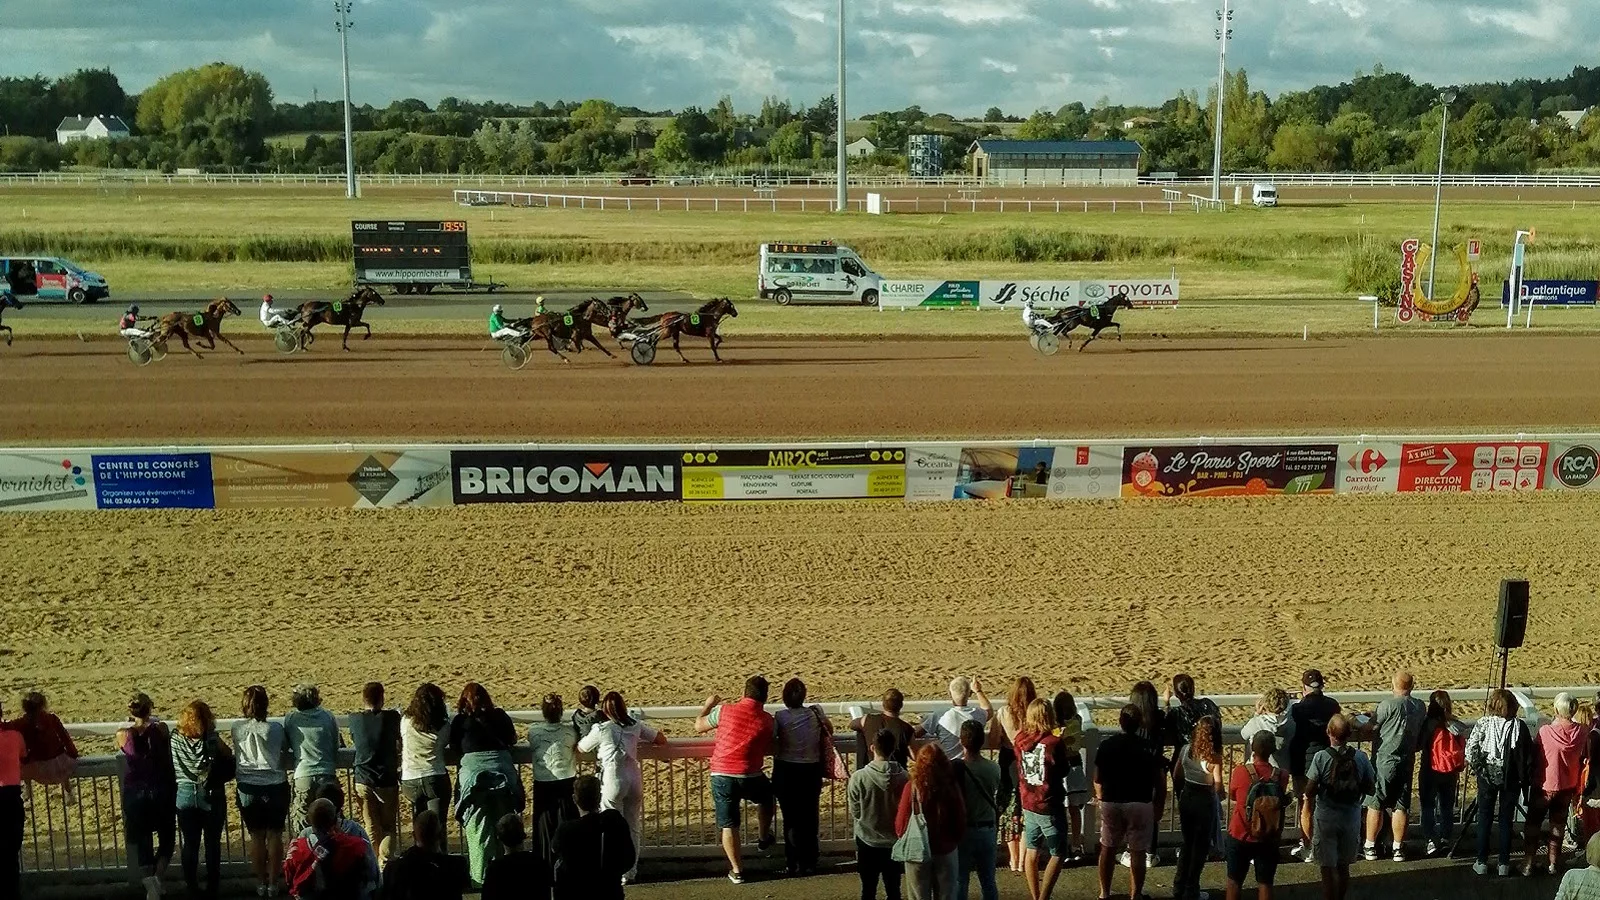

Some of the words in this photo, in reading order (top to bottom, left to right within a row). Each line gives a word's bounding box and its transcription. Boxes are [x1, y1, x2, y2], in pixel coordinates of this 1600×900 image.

[442, 222, 466, 231] 19:54
[375, 270, 450, 279] www.hippornichet.fr
[1399, 239, 1418, 322] CASINO
[890, 283, 925, 293] CHARIER
[1108, 284, 1173, 296] TOYOTA
[1532, 284, 1587, 297] atlantique
[1020, 286, 1070, 302] Séché
[1420, 448, 1435, 458] MIN
[98, 461, 134, 470] CENTRE
[152, 459, 200, 469] CONGRÈS
[768, 450, 817, 468] MR2C
[917, 457, 953, 468] Oceania
[1163, 451, 1189, 473] Le
[1190, 451, 1235, 474] Paris
[1238, 451, 1282, 475] Sport
[1563, 455, 1595, 471] RCA
[100, 471, 112, 479] DE
[115, 471, 186, 479] L'HIPPODROME
[459, 465, 674, 494] BRICOMAN
[1196, 471, 1209, 479] BAR
[1213, 471, 1228, 479] PMU
[1232, 471, 1244, 479] FDJ
[1345, 475, 1386, 483] Carrefour
[1414, 476, 1462, 484] DIRECTION
[0, 474, 69, 491] ornichet
[1350, 484, 1378, 492] market
[102, 489, 134, 497] Organisez
